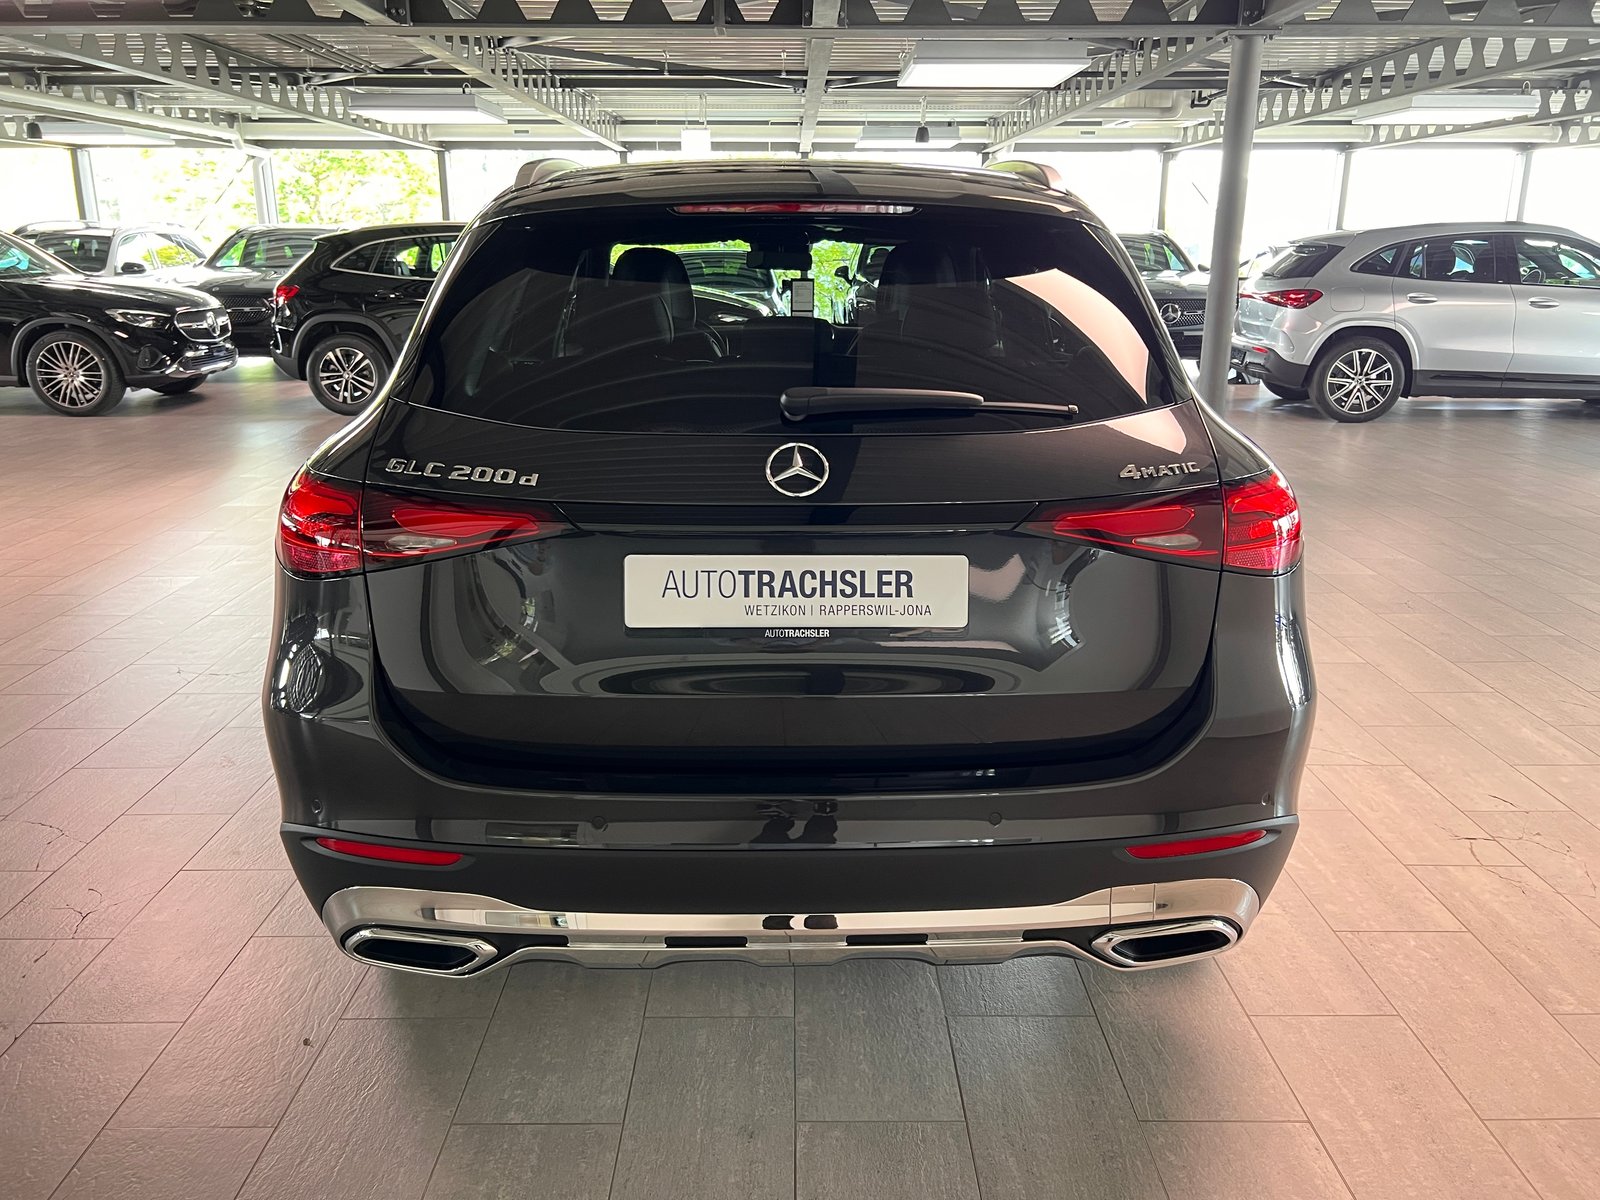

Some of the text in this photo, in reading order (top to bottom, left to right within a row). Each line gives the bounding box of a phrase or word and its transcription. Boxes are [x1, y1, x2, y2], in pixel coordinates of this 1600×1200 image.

[385, 457, 446, 477] GLC
[448, 464, 517, 484] 200
[1119, 461, 1200, 480] 4MATIC
[661, 569, 914, 599] AUTOTRACHSLER
[744, 604, 807, 616] WETZIKON
[818, 604, 932, 616] RAPPERSWIL-JONA
[764, 629, 830, 638] AUTOTRACHSLER
